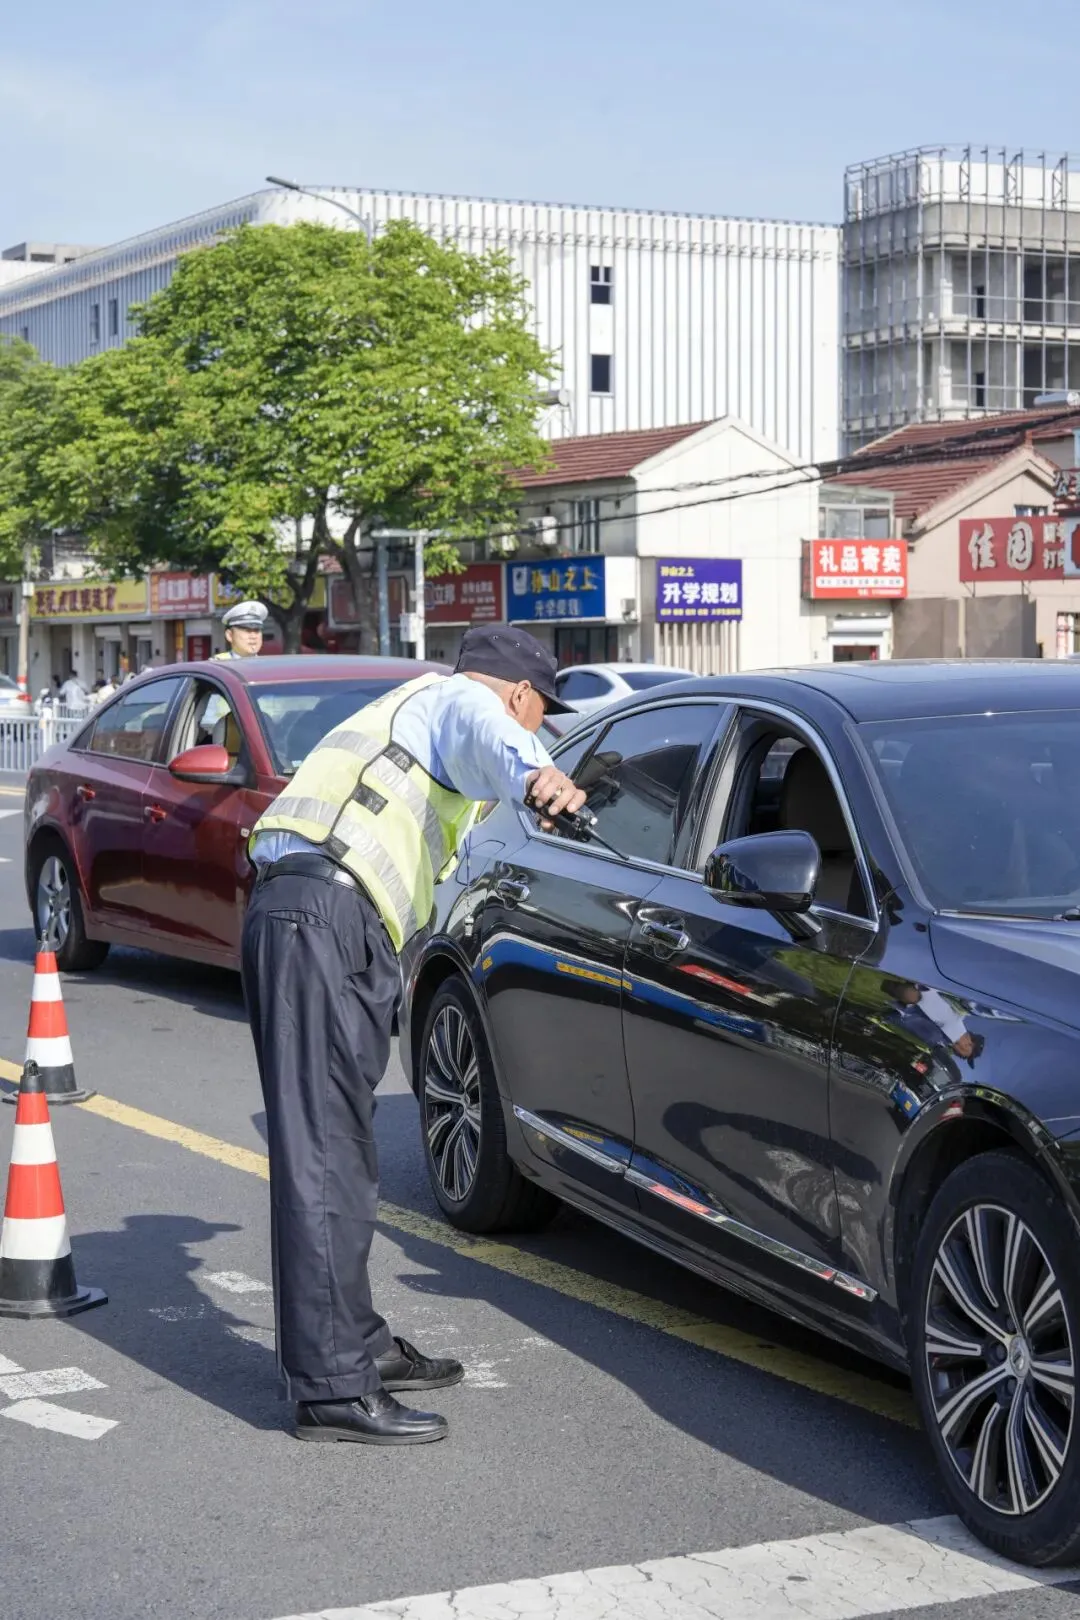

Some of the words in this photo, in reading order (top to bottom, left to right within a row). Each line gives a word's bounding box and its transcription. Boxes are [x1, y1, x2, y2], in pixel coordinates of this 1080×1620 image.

[819, 545, 901, 573] 礼品寄卖
[662, 582, 738, 604] 升学规划
